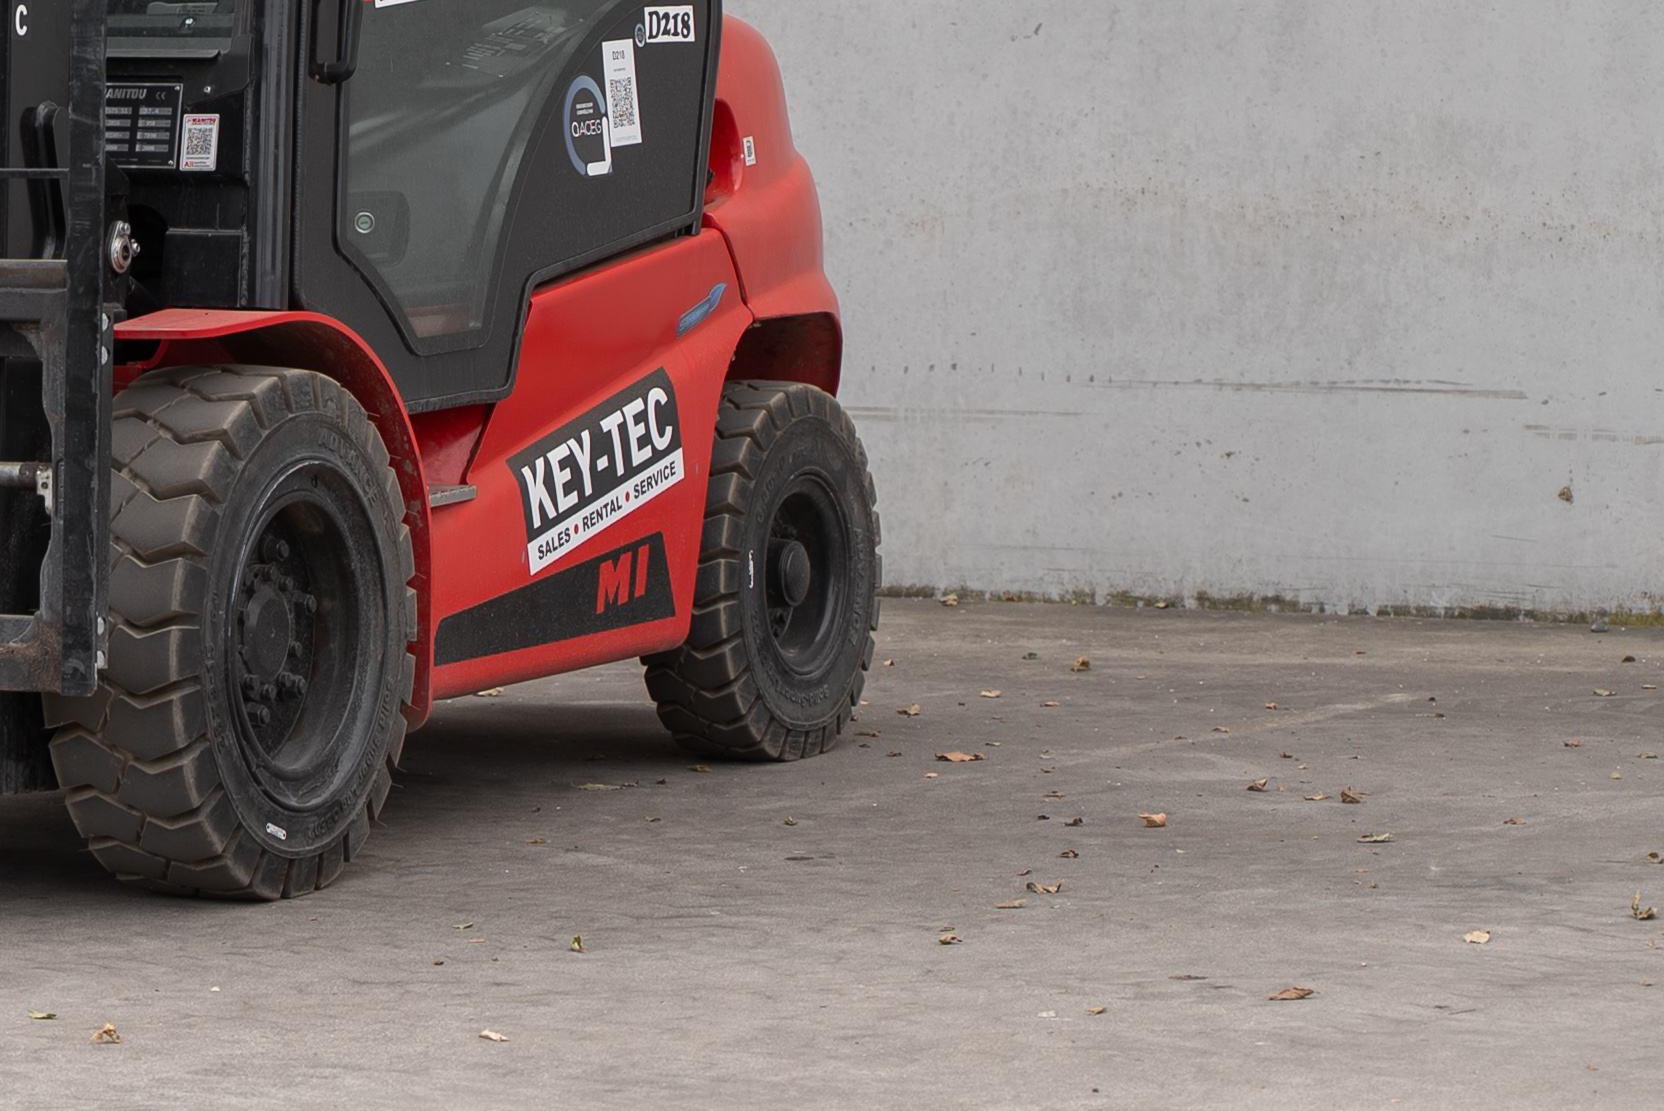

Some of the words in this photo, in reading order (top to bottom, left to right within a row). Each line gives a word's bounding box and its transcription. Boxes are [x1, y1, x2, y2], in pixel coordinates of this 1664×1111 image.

[612, 50, 626, 61] D218
[647, 10, 691, 40] D218
[104, 88, 147, 100] ANITOU
[317, 426, 379, 508] ADVANCE
[521, 386, 673, 529] KEY-TEC
[537, 527, 572, 561] SALES
[582, 495, 623, 533] RENTAL
[633, 459, 677, 500] SERVICE
[596, 542, 651, 616] MI
[848, 528, 866, 648] ADVANCE
